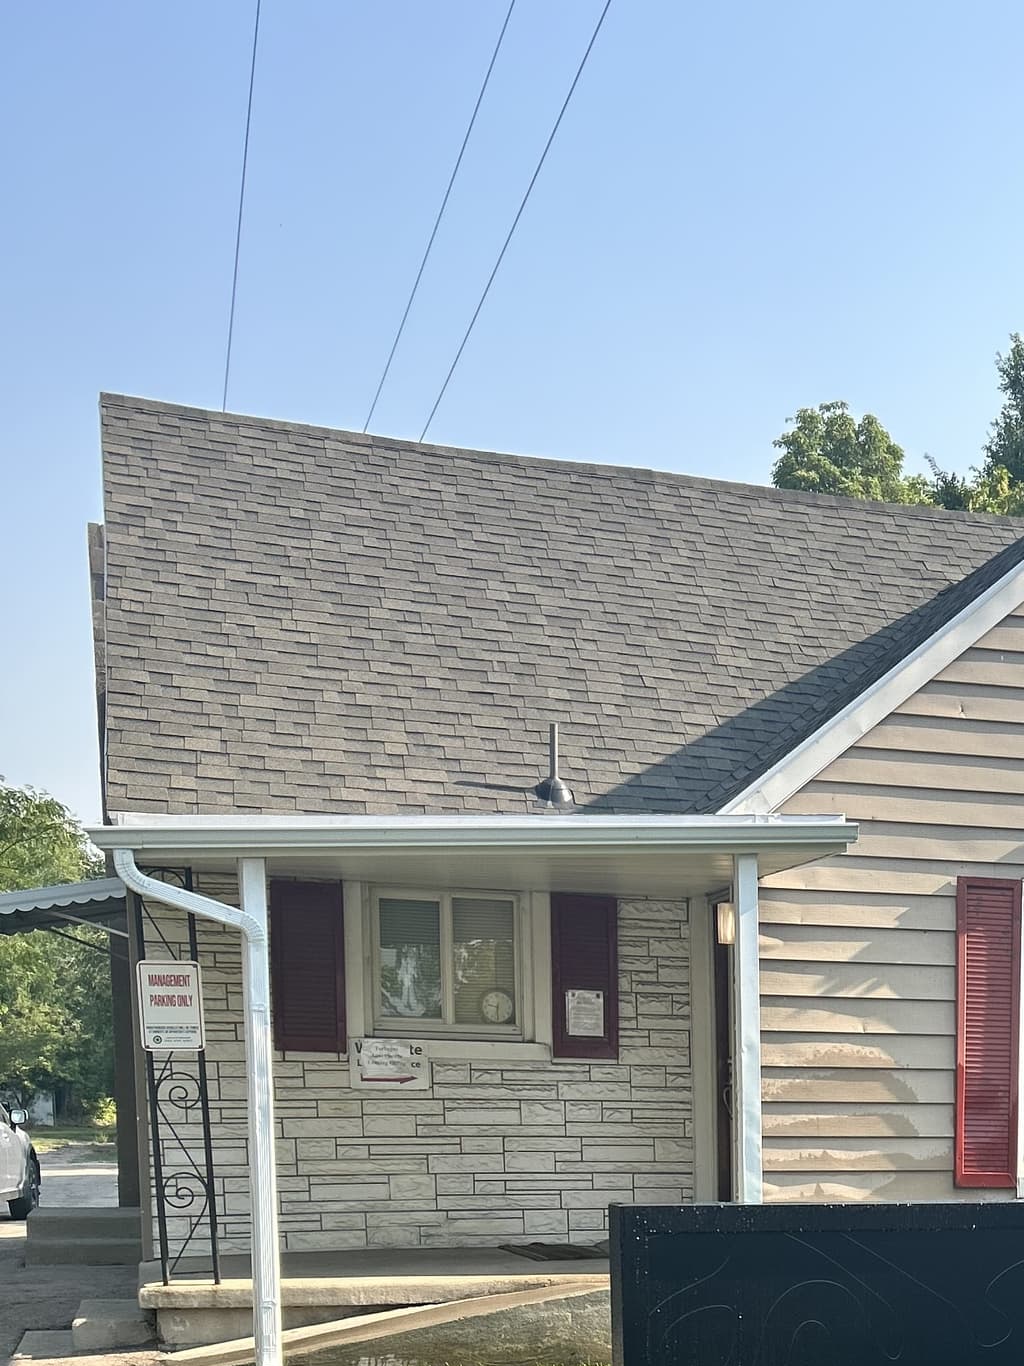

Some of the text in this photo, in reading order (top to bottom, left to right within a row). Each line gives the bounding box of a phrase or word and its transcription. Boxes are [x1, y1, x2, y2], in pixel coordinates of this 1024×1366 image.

[148, 974, 191, 987] MANAGEMENT
[150, 994, 193, 1007] PARKING ONLY
